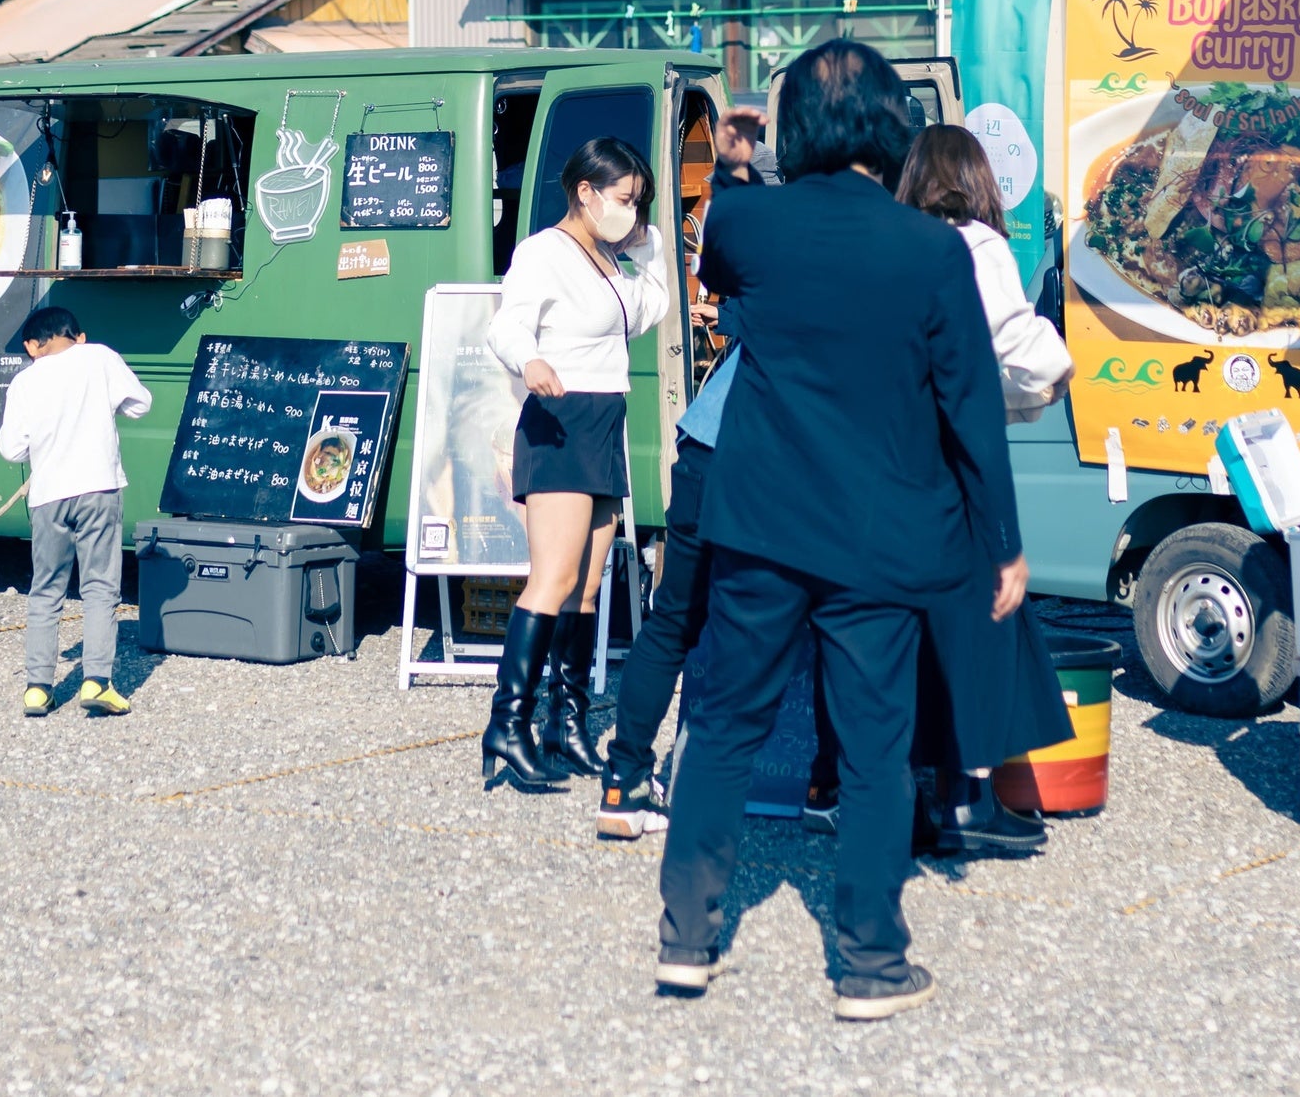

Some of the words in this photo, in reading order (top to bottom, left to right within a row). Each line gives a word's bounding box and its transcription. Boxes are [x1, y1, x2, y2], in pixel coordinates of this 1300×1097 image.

[1192, 31, 1295, 81] curry
[1212, 109, 1235, 130] of
[370, 136, 417, 151] DRINK
[347, 161, 414, 186] 生ビール
[418, 163, 438, 173] 800
[266, 192, 320, 221] RAMEN
[353, 197, 385, 206] レモンサワー
[353, 208, 384, 217] ハイボール
[373, 257, 388, 266] 600
[0, 356, 23, 365] STAND
[339, 375, 360, 387] 900
[197, 390, 276, 414] 豚骨白湯らーめん
[284, 405, 303, 417] 900
[193, 430, 270, 451] ラー油のまぜそば
[271, 440, 290, 454] 900
[186, 464, 264, 484] ねぎ油のまぜそば
[270, 472, 289, 486] 800
